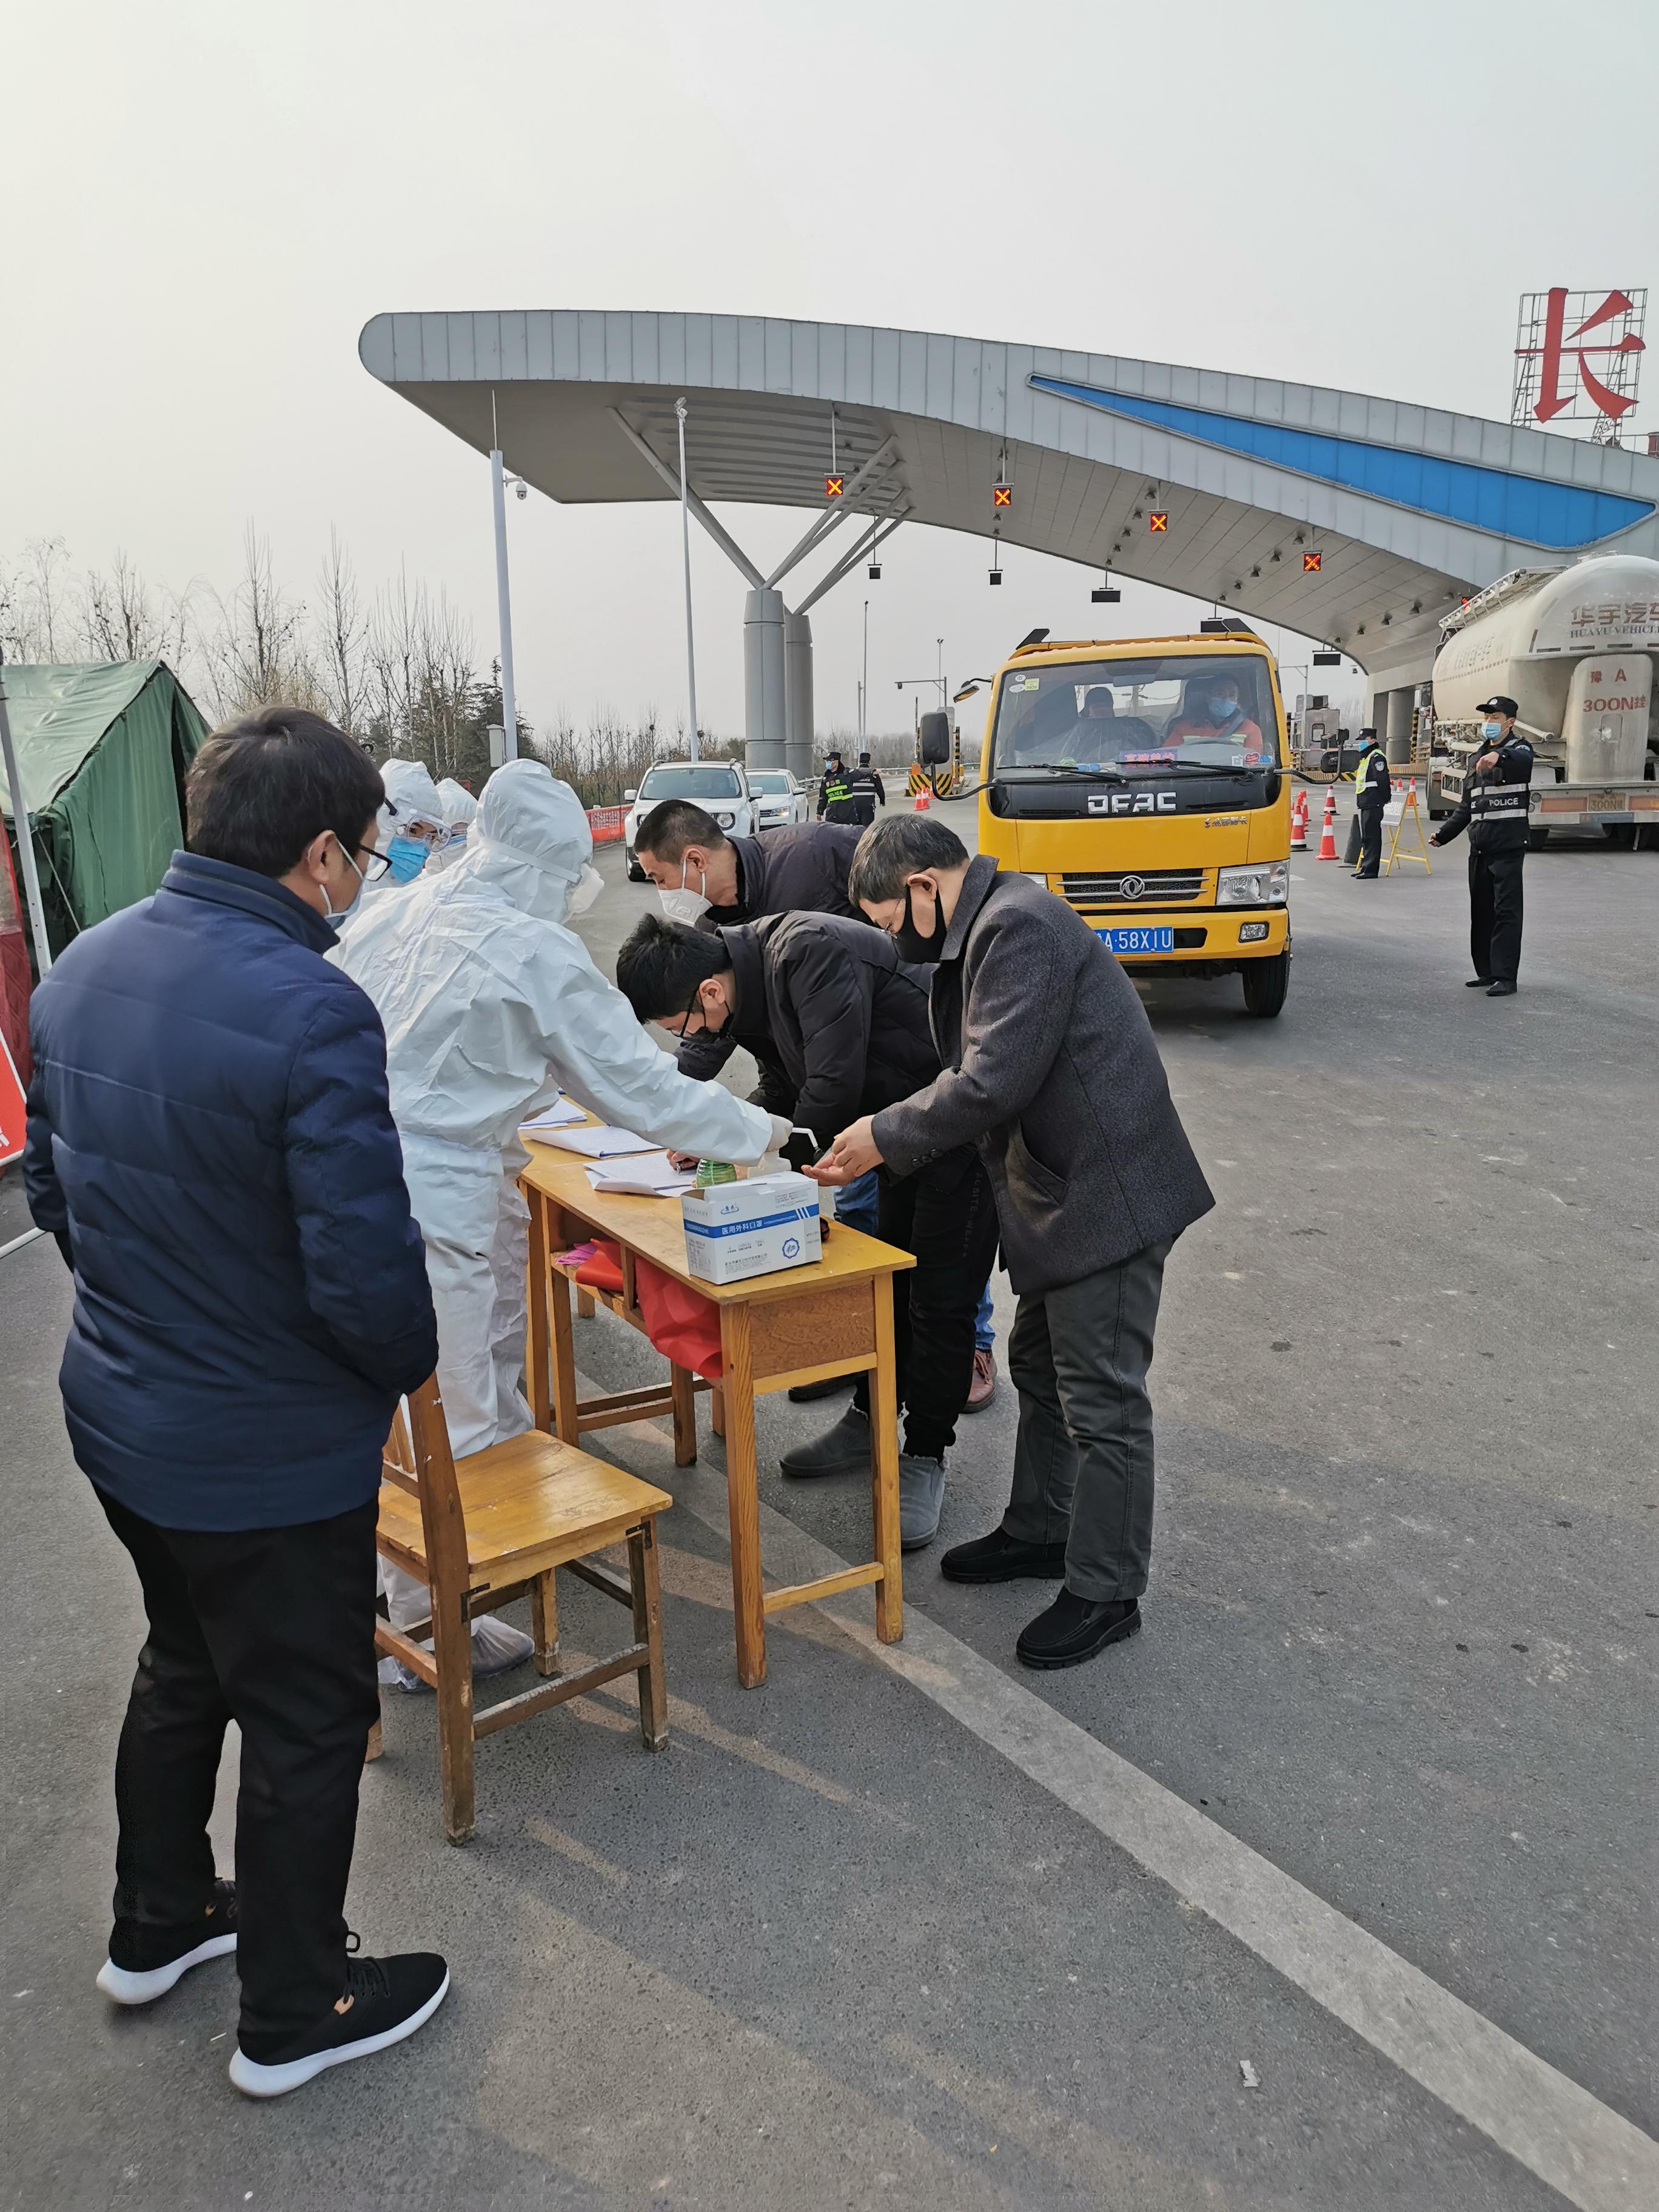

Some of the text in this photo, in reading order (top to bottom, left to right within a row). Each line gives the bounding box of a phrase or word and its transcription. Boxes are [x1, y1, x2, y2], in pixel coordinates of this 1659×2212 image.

[1513, 287, 1646, 424] 长
[1570, 627, 1610, 638] HUAYU
[1590, 668, 1627, 684] 豫 A
[1087, 791, 1177, 814] DFAC
[1489, 797, 1519, 806] POLICE
[1096, 930, 1171, 950] A·58X1U
[722, 1219, 763, 1235] 医用外科口罩
